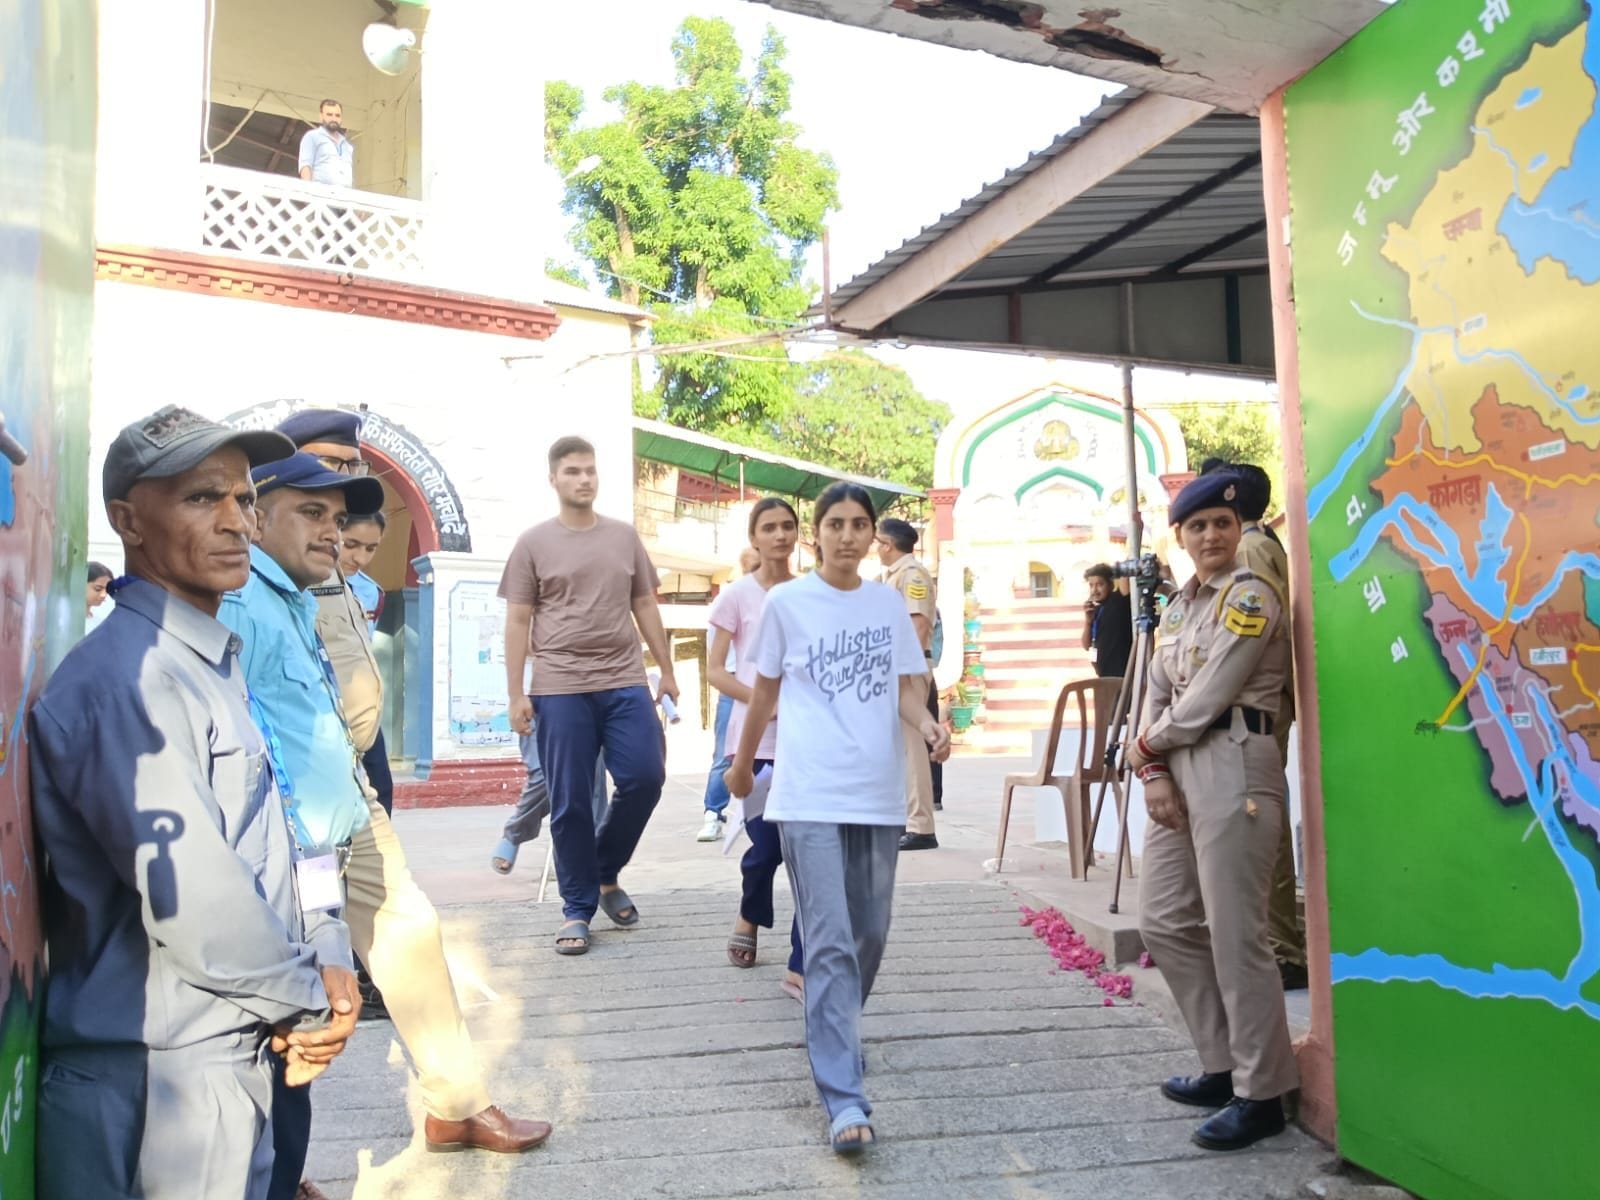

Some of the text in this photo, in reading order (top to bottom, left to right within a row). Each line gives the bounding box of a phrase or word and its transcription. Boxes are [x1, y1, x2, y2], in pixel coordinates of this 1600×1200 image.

[1393, 91, 1435, 155] और
[806, 626, 892, 684] Hollister
[818, 649, 892, 702] Surfing
[857, 674, 888, 703] Co.
